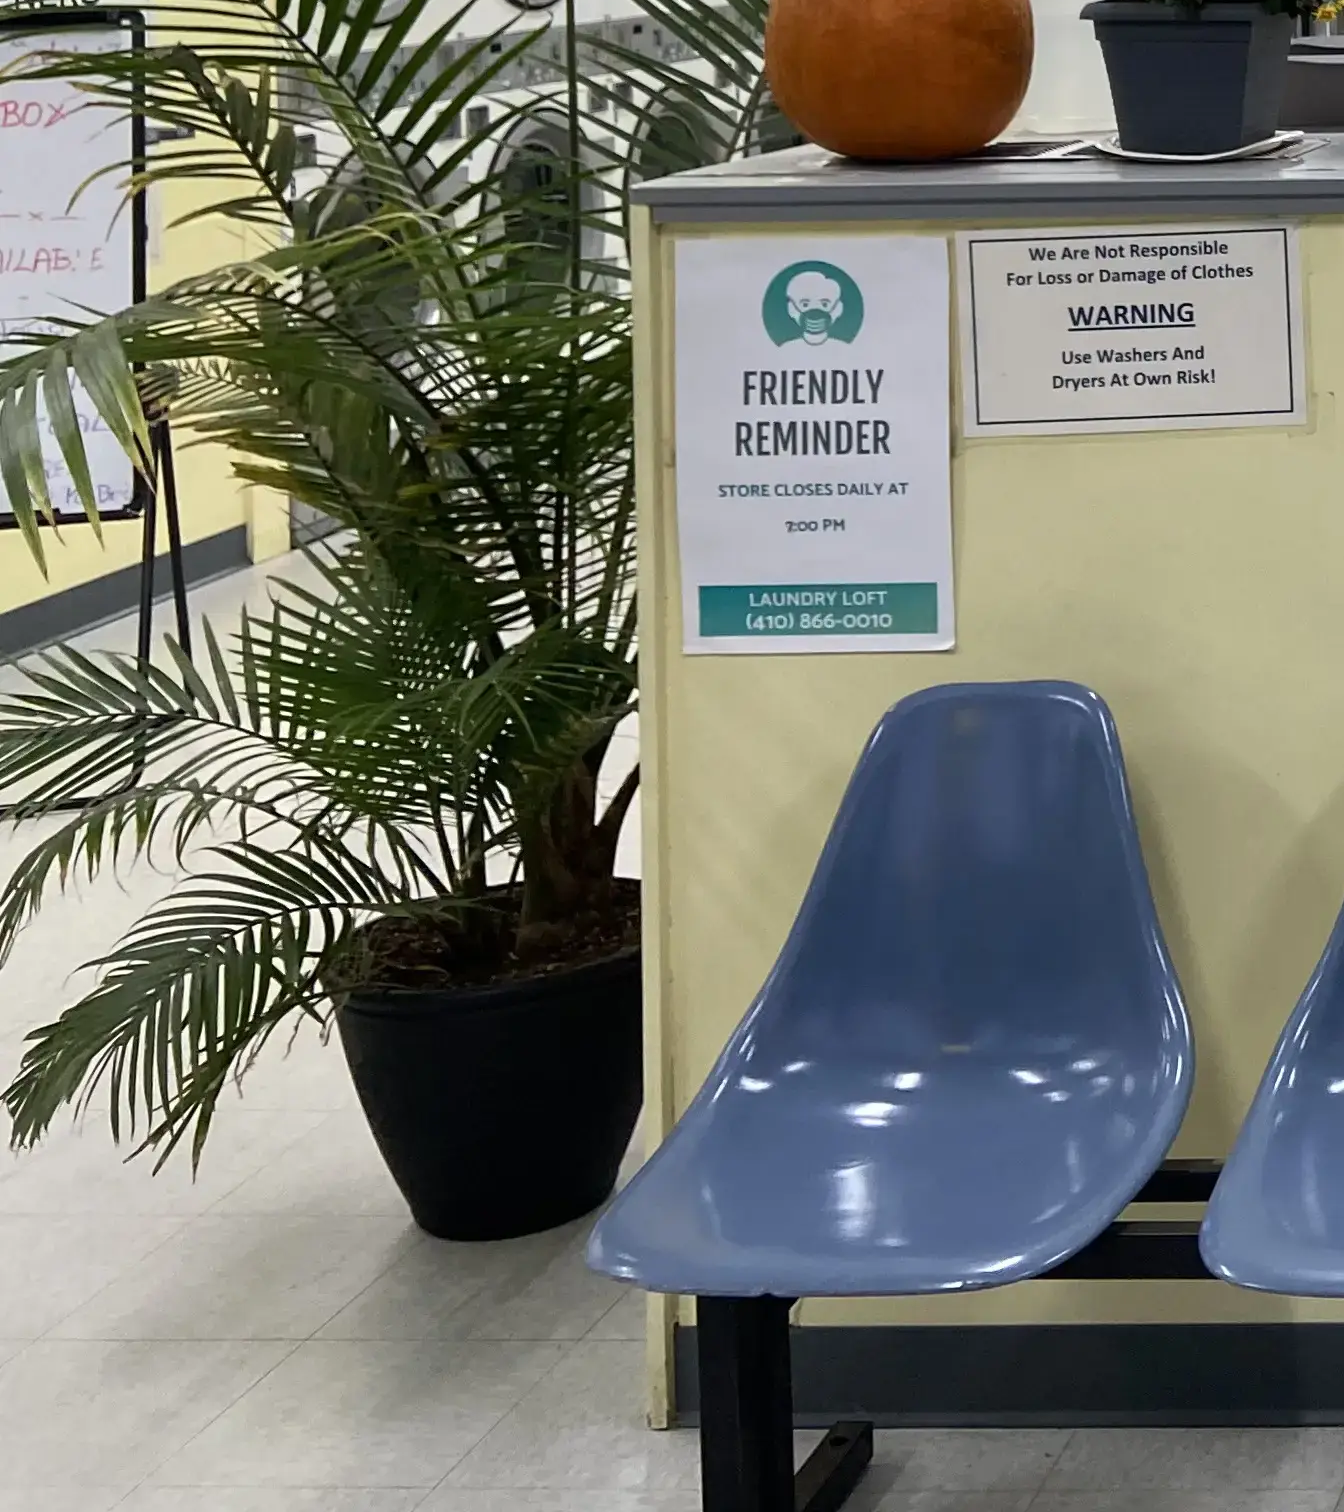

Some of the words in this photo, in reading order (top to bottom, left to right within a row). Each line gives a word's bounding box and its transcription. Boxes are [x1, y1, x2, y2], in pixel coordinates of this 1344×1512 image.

[1028, 247, 1057, 261] We
[1061, 246, 1090, 261] Are
[1094, 245, 1125, 259] Not
[1130, 240, 1229, 260] Responsible
[1007, 272, 1033, 286] For
[1038, 271, 1072, 285] Loss
[1077, 272, 1095, 284] or
[1099, 268, 1166, 284] Damage
[1171, 265, 1188, 280] of
[1192, 263, 1254, 280] Clothes
[1067, 302, 1196, 327] WARNING
[1062, 350, 1092, 365] Use
[1096, 347, 1167, 364] Washers
[1172, 345, 1205, 361] And
[743, 369, 884, 405] FRIENDLY
[1052, 375, 1105, 391] Dryers
[1110, 372, 1129, 387] At
[1133, 372, 1172, 386] Own
[1176, 368, 1216, 384] Risk!
[735, 420, 891, 456] REMINDER
[718, 484, 770, 498] STORE
[774, 483, 834, 497] CLOSES
[838, 482, 884, 496] DAILY
[887, 482, 909, 495] AT
[822, 518, 846, 531] PM
[749, 591, 837, 607] LAUNDRY
[842, 590, 888, 606] LOFT
[746, 613, 795, 631] (410)
[799, 613, 893, 629] 866-0010
